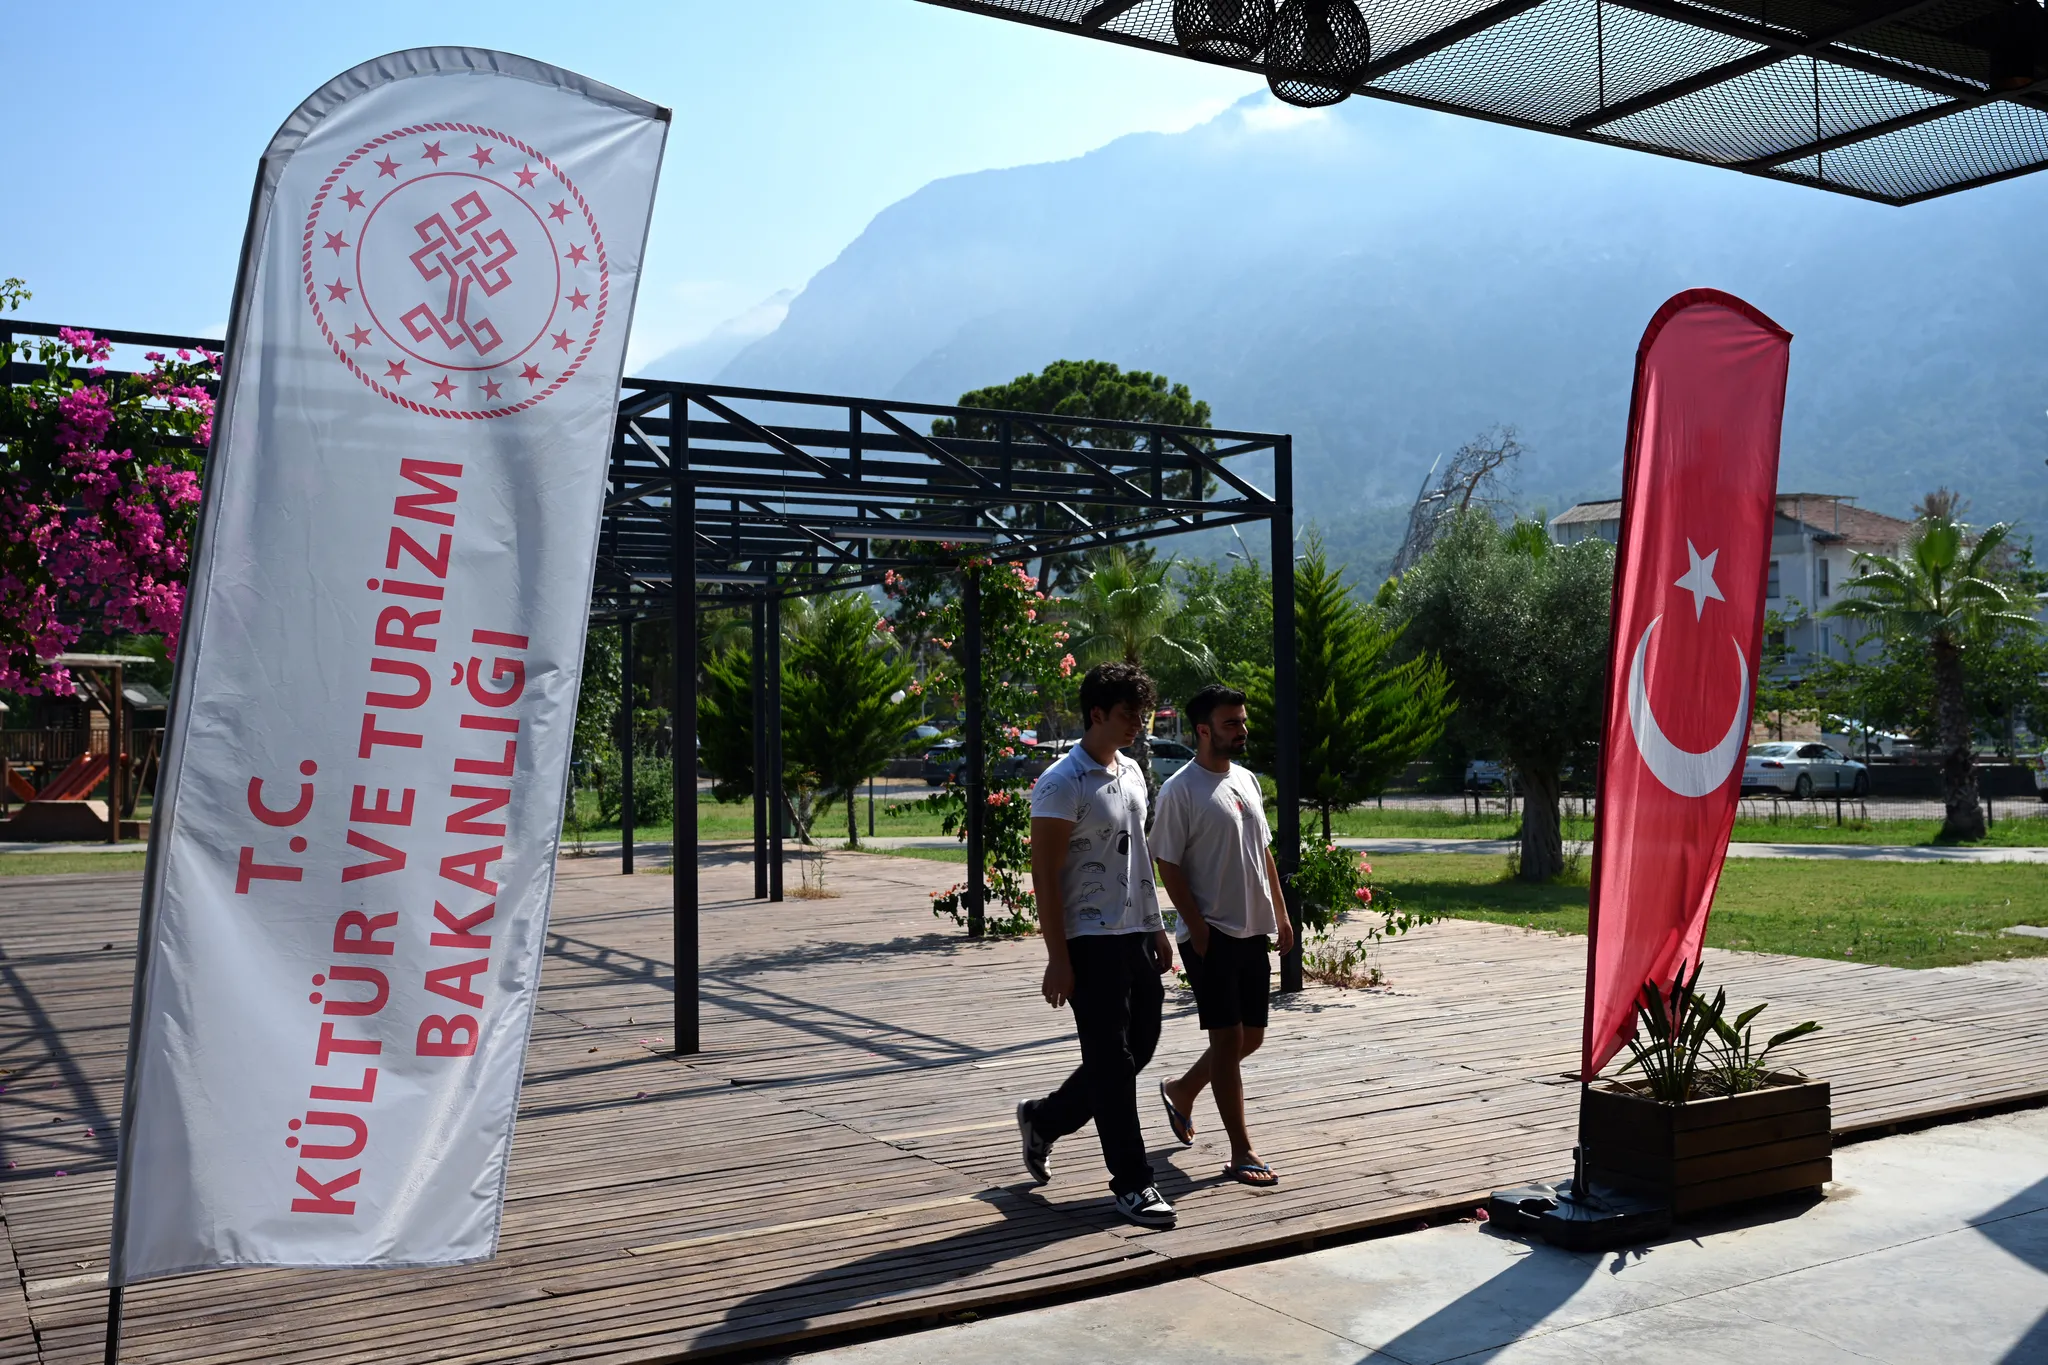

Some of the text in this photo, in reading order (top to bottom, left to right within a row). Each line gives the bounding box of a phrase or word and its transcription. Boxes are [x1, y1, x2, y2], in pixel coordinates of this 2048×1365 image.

[235, 759, 318, 895] T.C.
[285, 457, 464, 1215] KÜLTÜR VE TURİZM
[415, 629, 529, 1057] BAKANLIĞI
